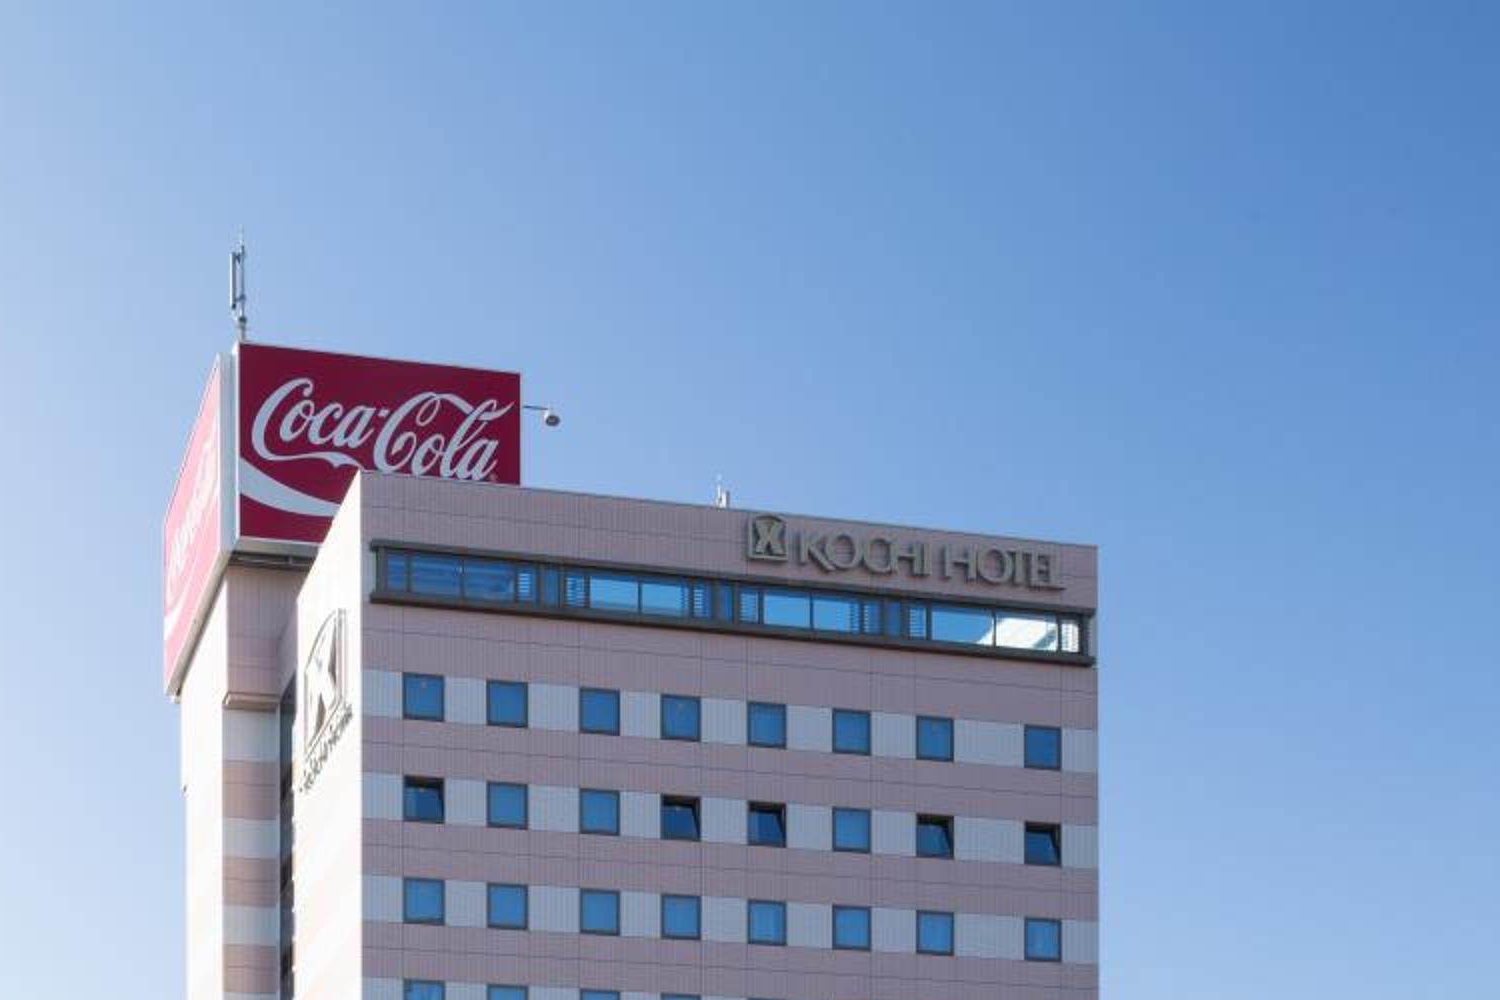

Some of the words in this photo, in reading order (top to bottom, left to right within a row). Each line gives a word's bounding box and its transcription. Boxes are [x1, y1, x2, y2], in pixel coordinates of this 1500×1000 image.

[251, 377, 514, 481] Coca-Cola
[795, 532, 933, 576] KOCHI
[944, 543, 1066, 590] HOTEL
